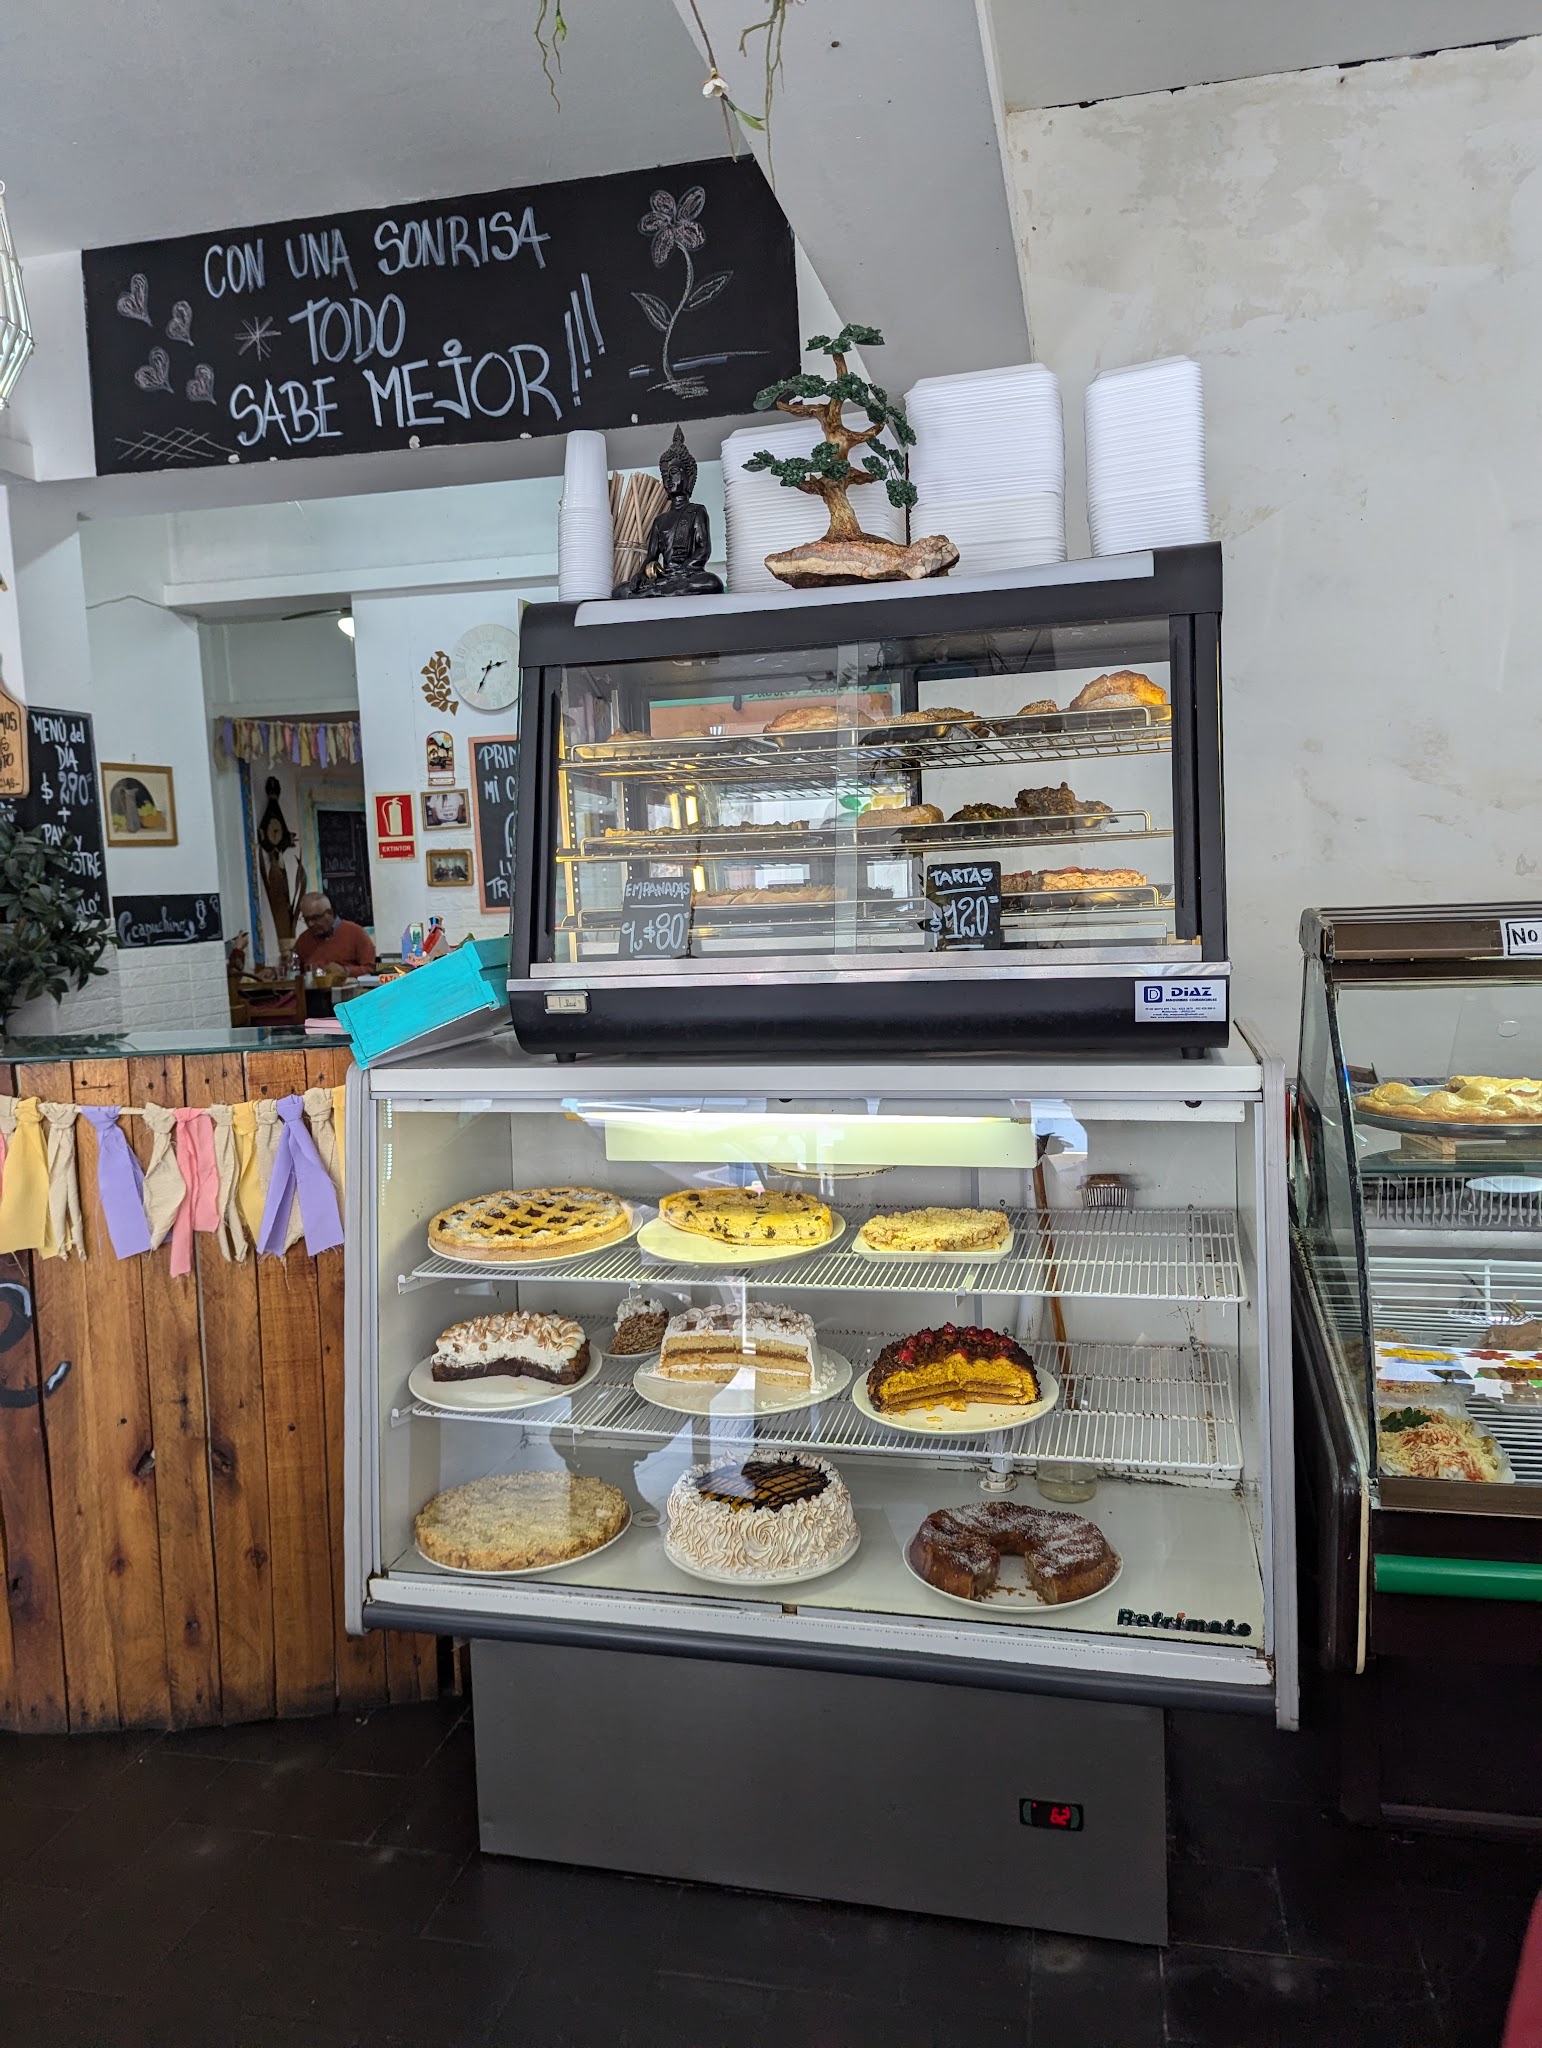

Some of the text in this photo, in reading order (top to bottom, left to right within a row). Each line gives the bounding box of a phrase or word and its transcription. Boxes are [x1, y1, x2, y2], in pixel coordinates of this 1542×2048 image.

[204, 206, 551, 298] CON UNA SONRISA
[288, 293, 406, 365] TODO
[229, 376, 343, 447] SABE
[31, 714, 67, 744] MENÚ
[70, 721, 85, 743] del
[55, 740, 79, 772] DÍA
[382, 845, 411, 853] EXTINTOR
[625, 882, 691, 900] EMPANADAS
[930, 867, 993, 887] TARTAS
[1511, 927, 1539, 946] No
